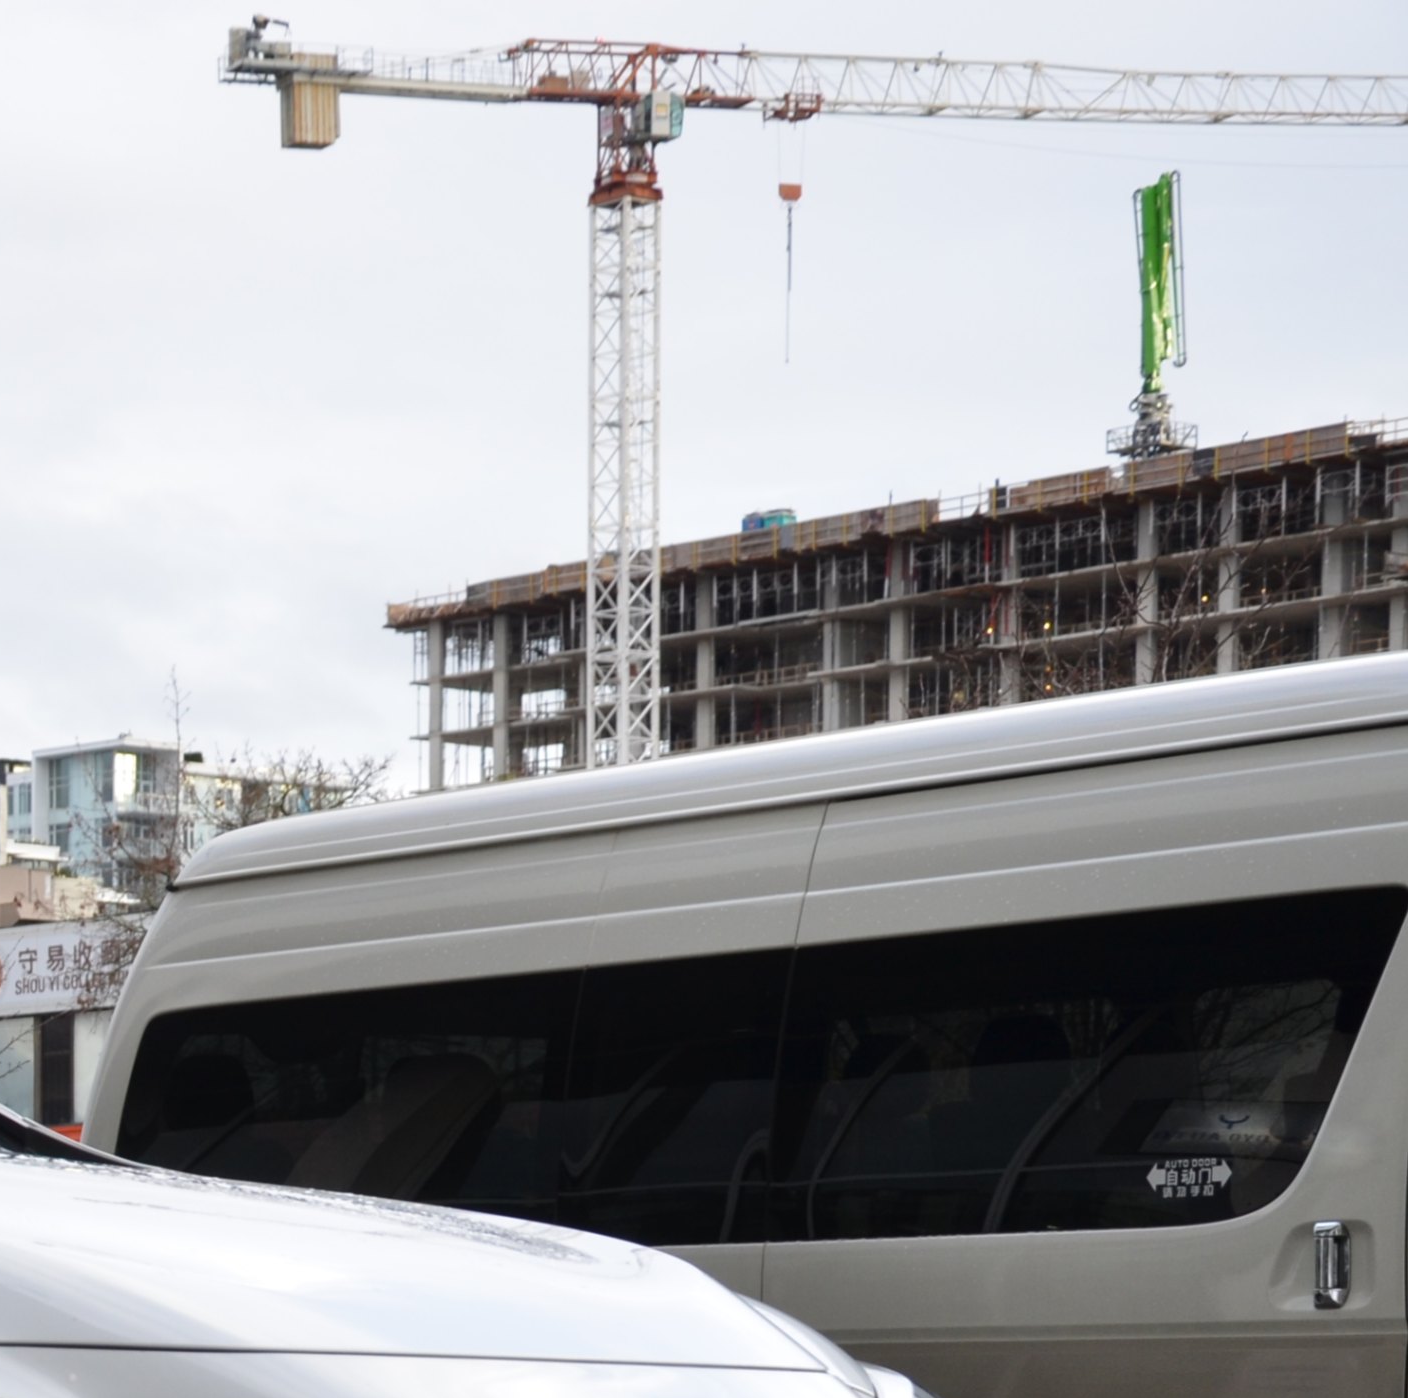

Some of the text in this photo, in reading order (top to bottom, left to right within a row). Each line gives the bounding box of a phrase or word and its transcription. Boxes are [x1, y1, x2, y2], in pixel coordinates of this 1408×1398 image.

[15, 978, 45, 995] SHOU
[49, 975, 61, 991] YI
[1165, 1158, 1217, 1168] AUTO DOOR
[1166, 1168, 1211, 1186] 自动门
